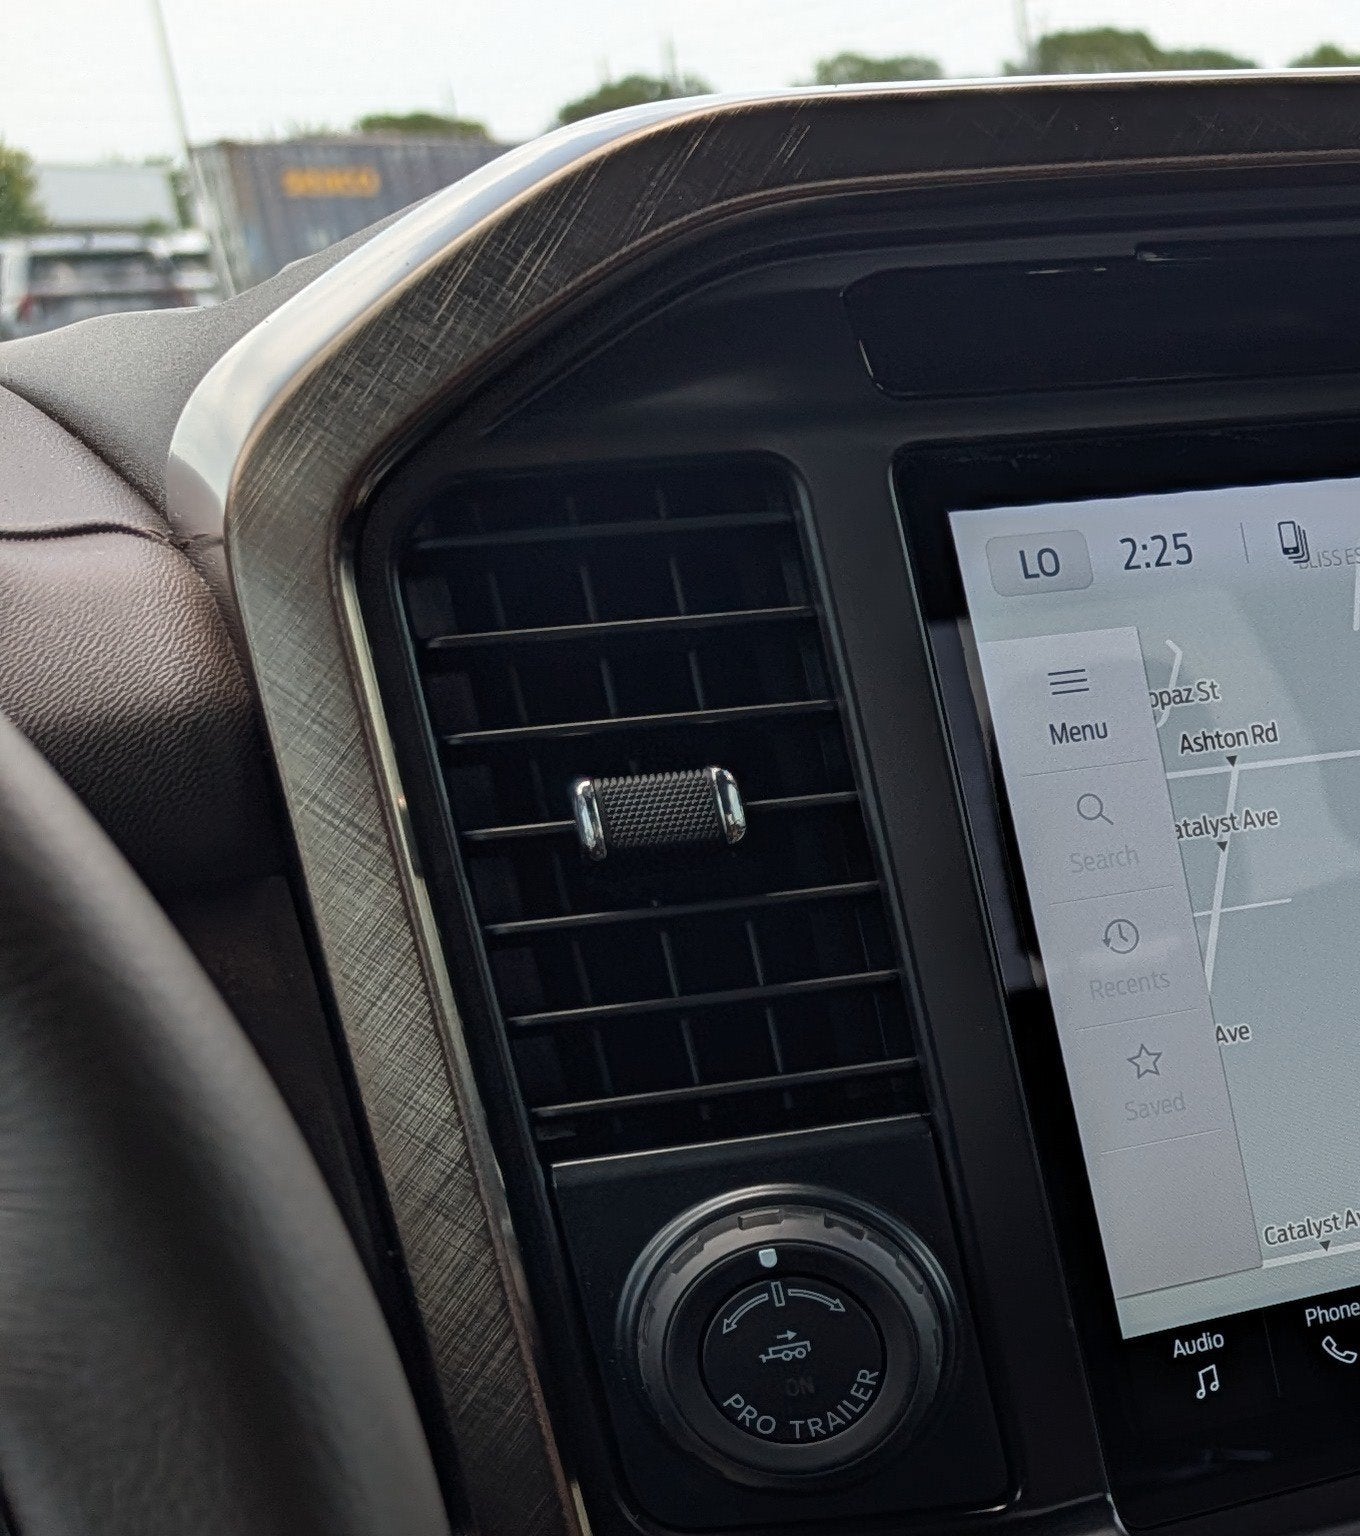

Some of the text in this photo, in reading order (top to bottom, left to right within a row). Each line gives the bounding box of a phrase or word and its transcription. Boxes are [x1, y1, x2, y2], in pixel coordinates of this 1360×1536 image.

[1019, 547, 1060, 580] LO
[1119, 532, 1194, 571] 2:25
[1298, 549, 1342, 570] LISS
[1196, 680, 1220, 702] St
[1049, 719, 1108, 746] Menu
[1179, 722, 1278, 755] Ashton Rd
[1243, 807, 1278, 828] Ave
[1070, 845, 1140, 875] Search
[1089, 970, 1171, 1000] Recents
[1215, 1024, 1250, 1044] Ave
[1125, 1093, 1186, 1122] Saved
[1264, 1215, 1340, 1245] Catalyst
[1305, 1300, 1360, 1327] Phone
[1172, 1331, 1224, 1357] Audio
[722, 1368, 880, 1439] PRO TRAILER
